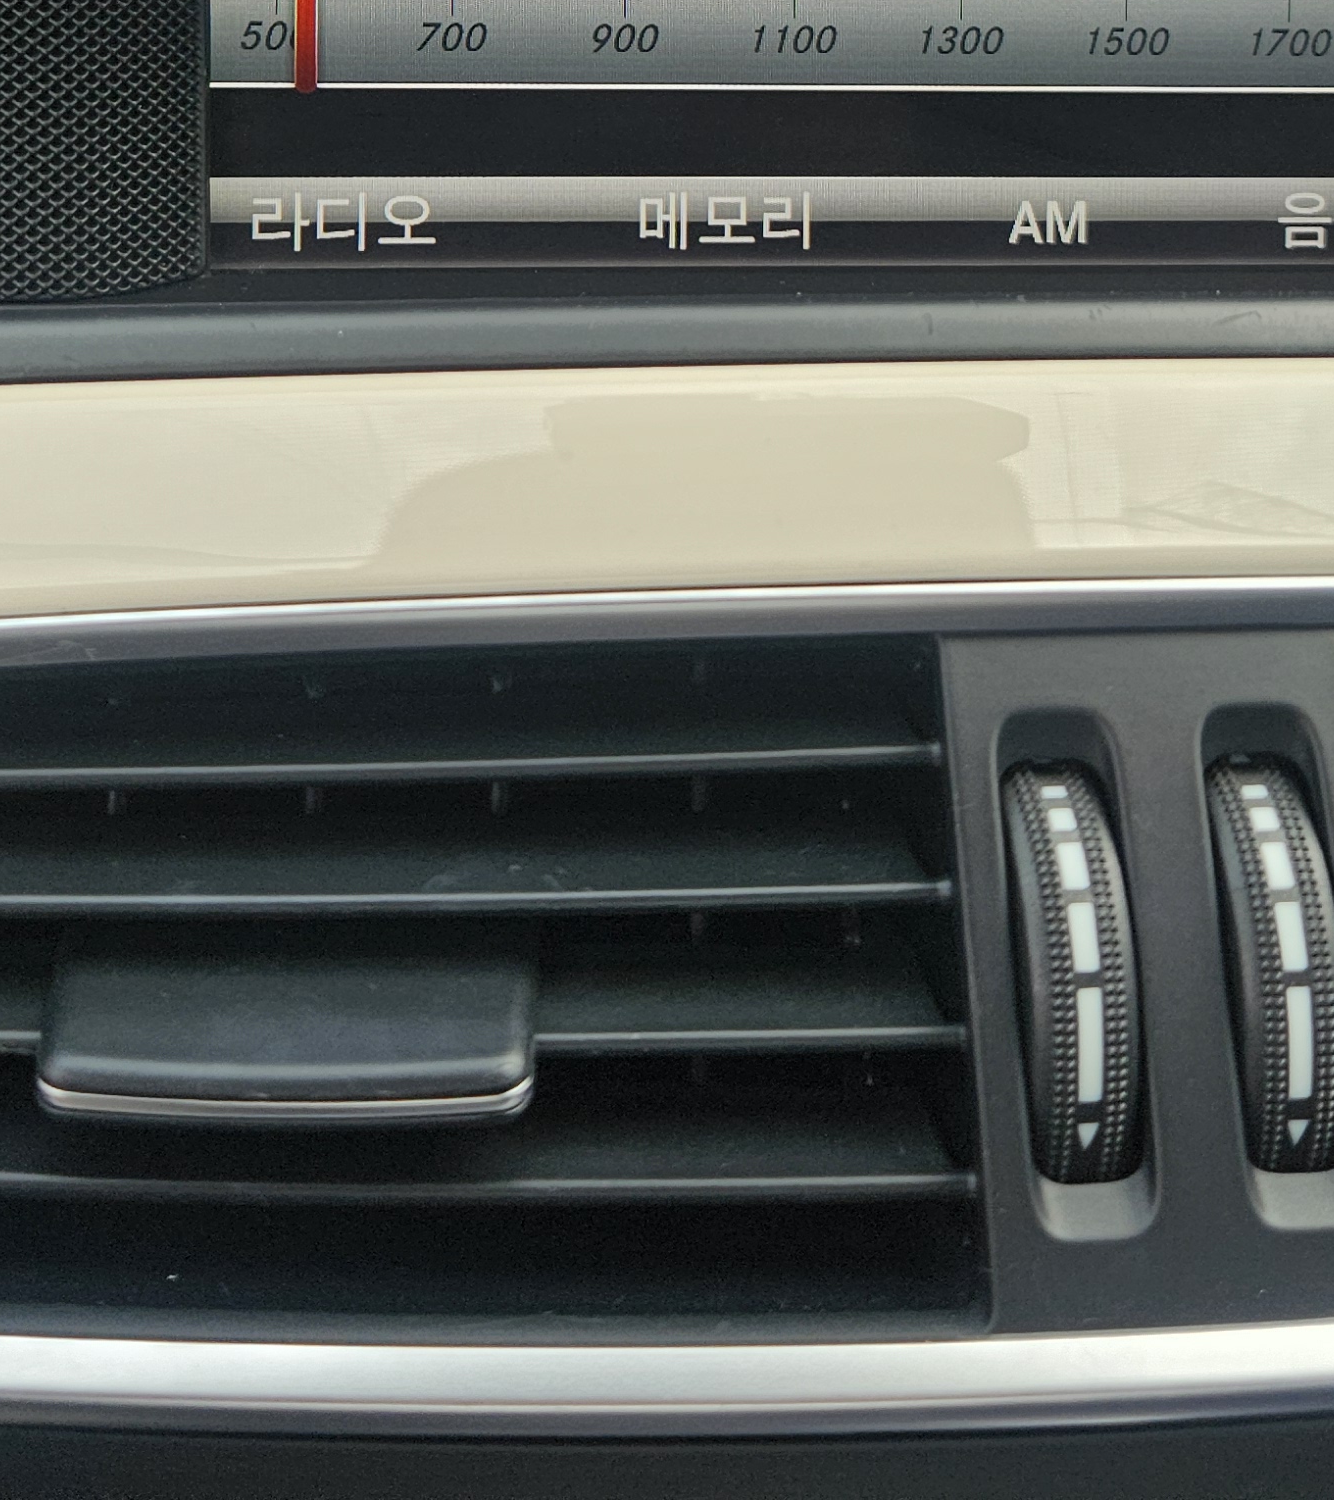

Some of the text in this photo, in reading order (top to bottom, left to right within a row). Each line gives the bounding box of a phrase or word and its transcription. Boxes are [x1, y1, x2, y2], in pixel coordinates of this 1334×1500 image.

[240, 20, 296, 51] 50
[416, 21, 488, 53] 700
[591, 23, 660, 54] 900
[753, 24, 838, 55] 1100
[920, 25, 1005, 57] 1300
[1088, 27, 1170, 57] 1500
[1251, 28, 1333, 58] 1700
[251, 192, 437, 252] 라디오
[638, 191, 811, 251] 메모리
[1008, 199, 1090, 246] AM
